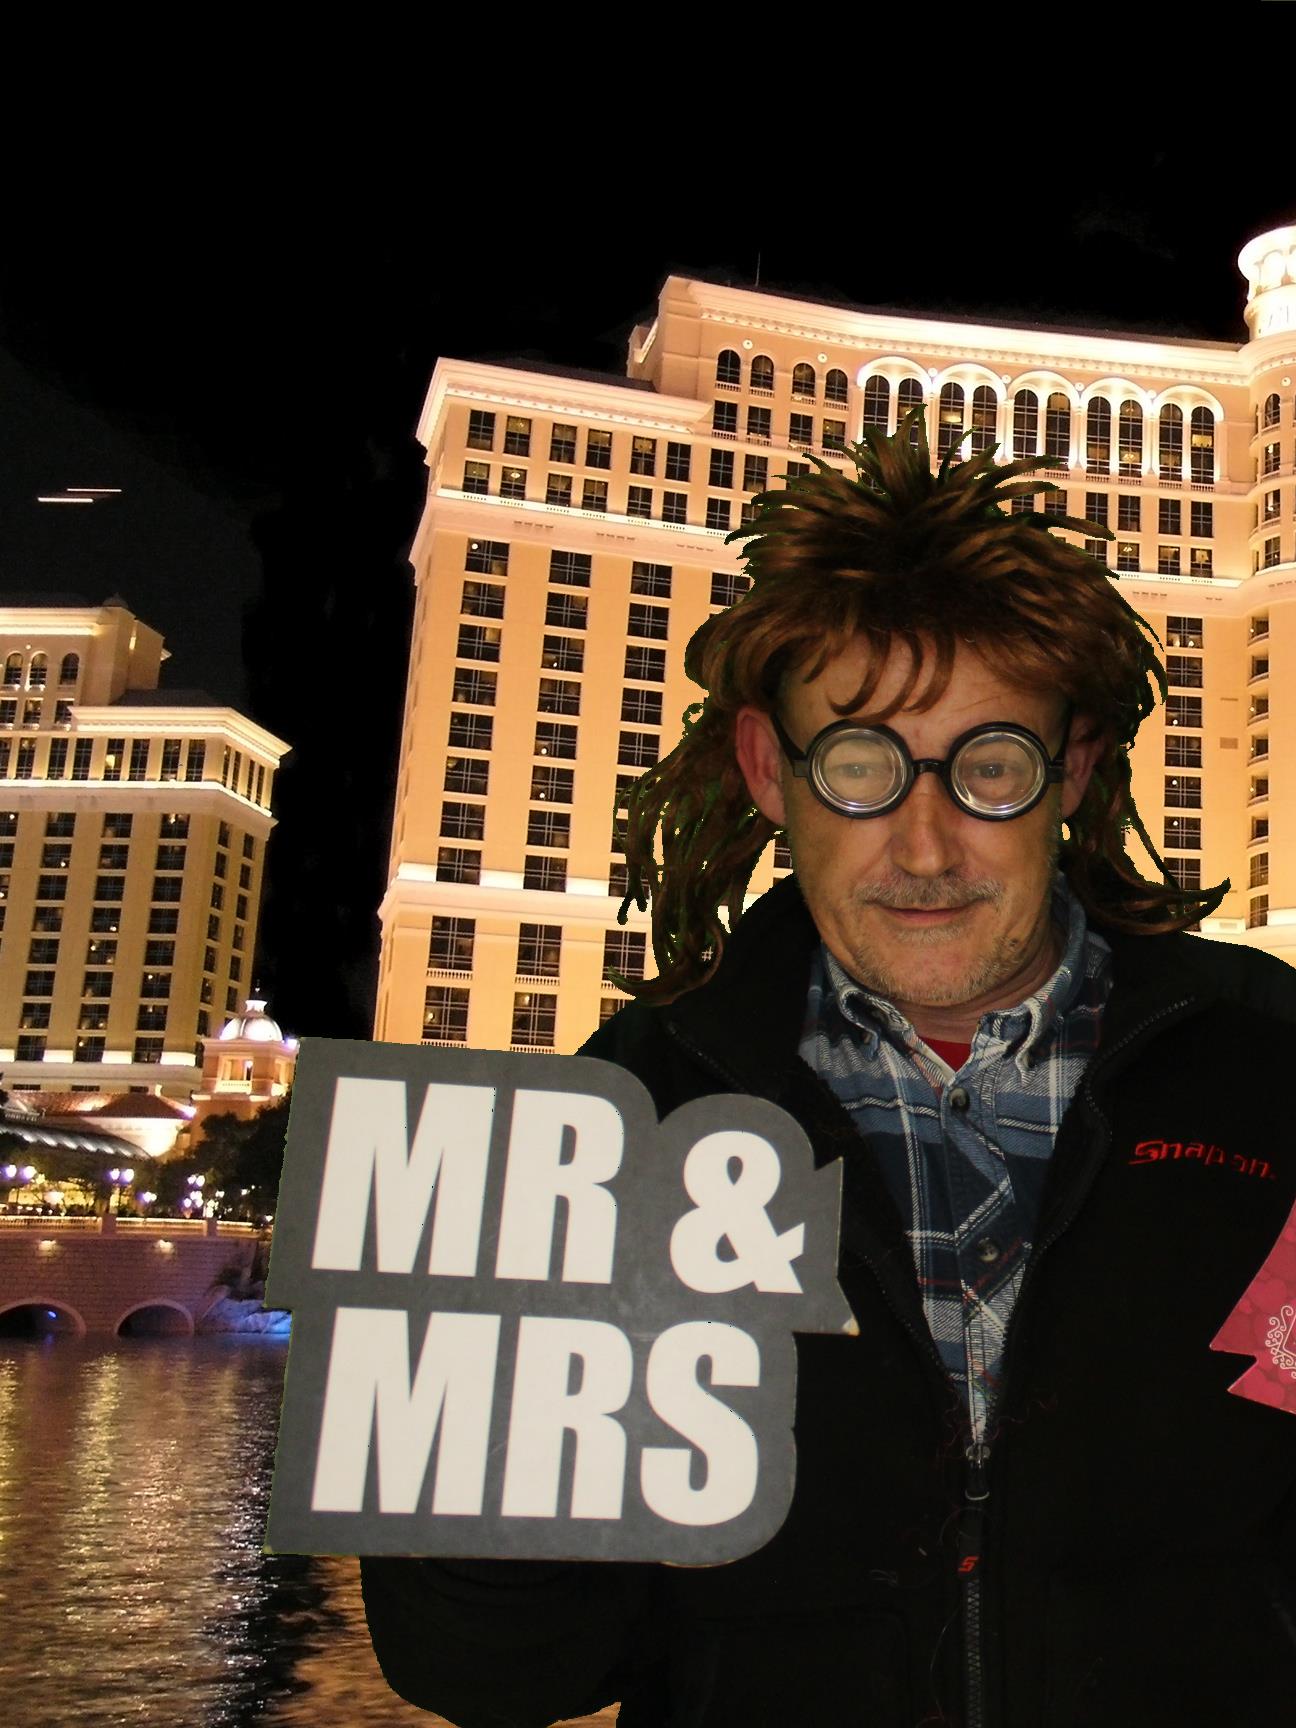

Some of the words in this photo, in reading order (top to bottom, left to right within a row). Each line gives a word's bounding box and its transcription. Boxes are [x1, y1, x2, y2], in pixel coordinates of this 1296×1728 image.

[311, 1076, 625, 1285] MR
[670, 1130, 806, 1295] &
[311, 1306, 762, 1526] MRS
